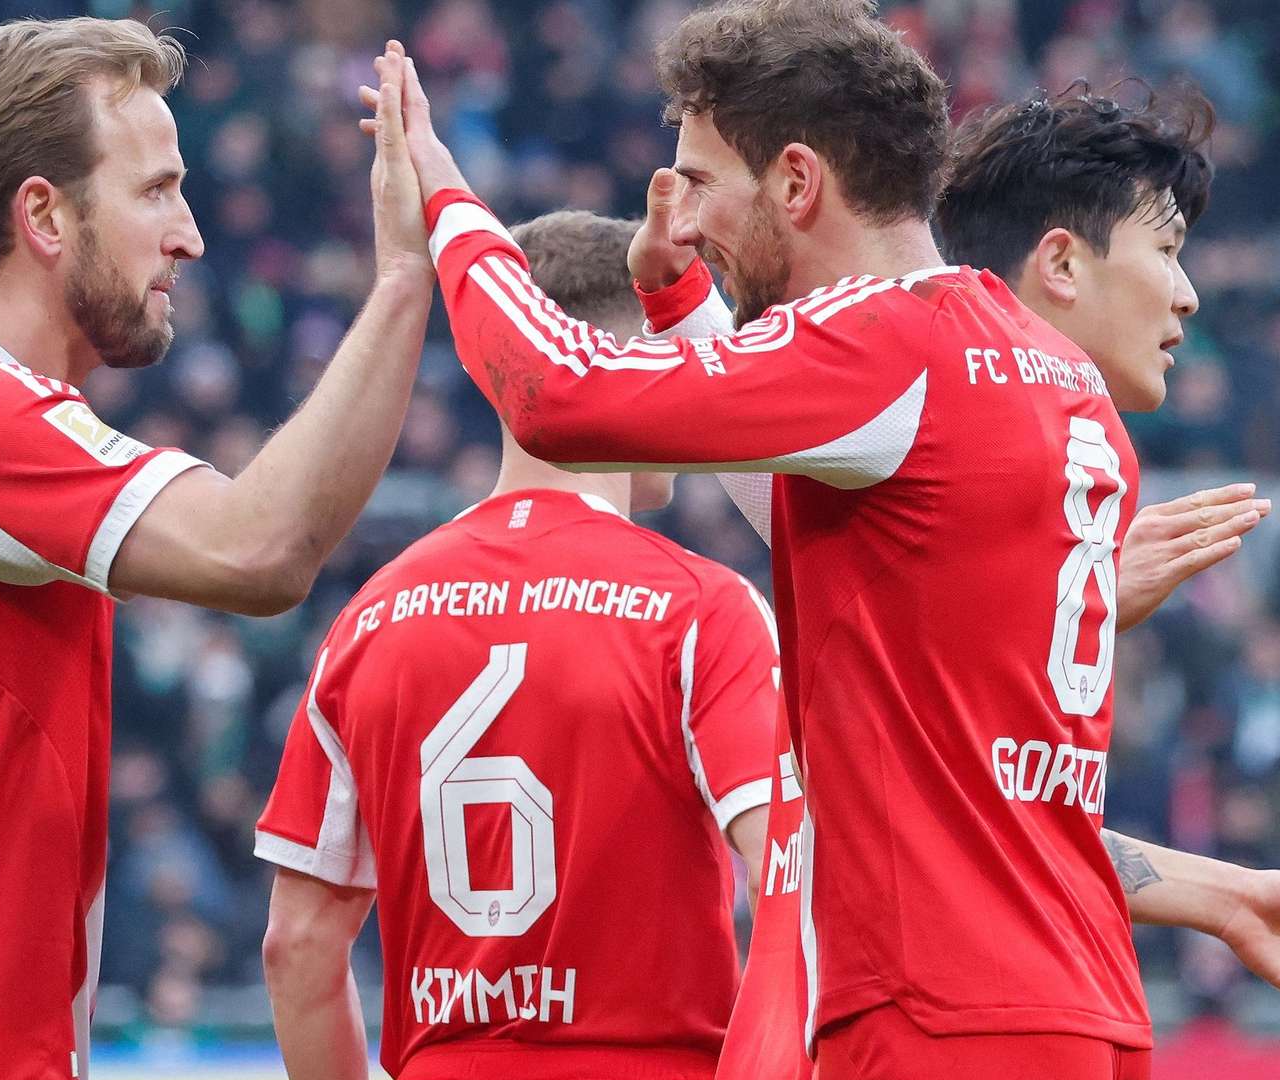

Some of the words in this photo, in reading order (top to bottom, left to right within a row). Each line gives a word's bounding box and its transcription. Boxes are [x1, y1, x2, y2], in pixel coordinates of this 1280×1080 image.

[965, 347, 1008, 385] FC
[354, 600, 386, 641] FC
[391, 581, 510, 621] BAYERN
[519, 577, 672, 622] MÜNCHEN
[1047, 416, 1127, 717] 8
[421, 642, 557, 937] 6
